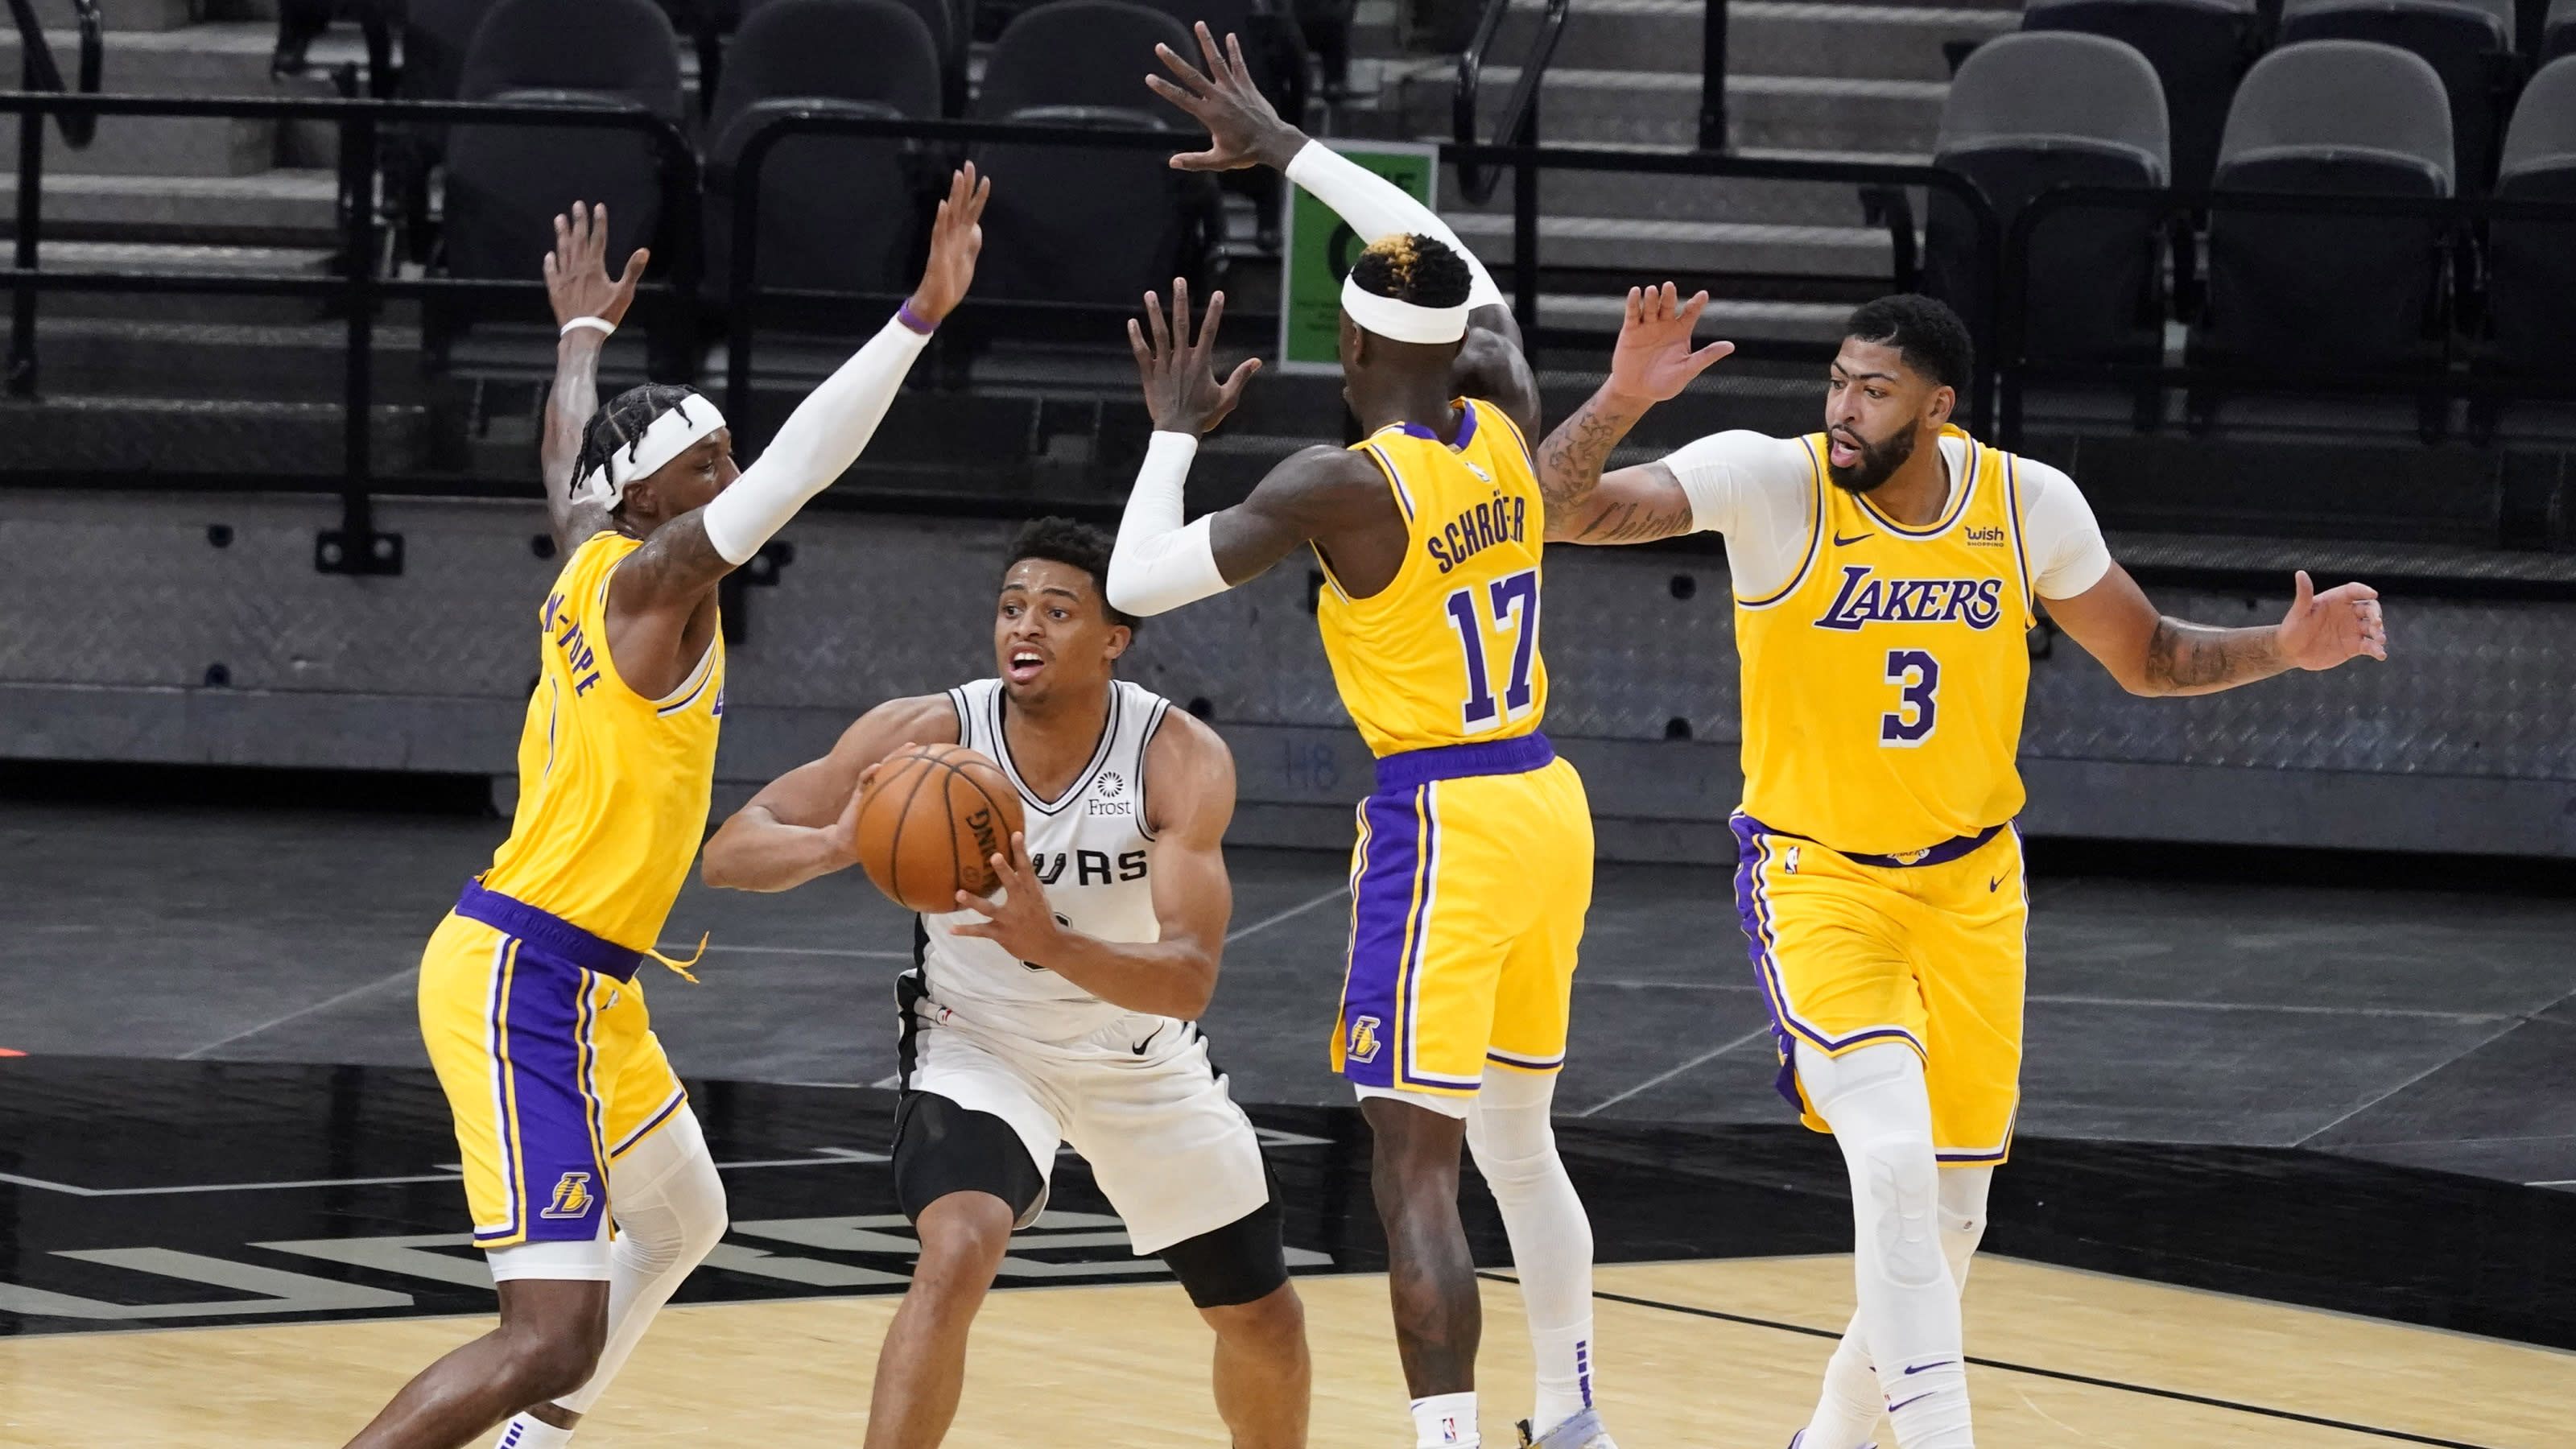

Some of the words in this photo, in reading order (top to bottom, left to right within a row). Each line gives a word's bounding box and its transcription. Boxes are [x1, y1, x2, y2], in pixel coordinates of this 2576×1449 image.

[1964, 526, 2004, 541] wish
[1811, 564, 2004, 632] LAKERS
[1444, 566, 1541, 736] 17
[1878, 648, 1942, 749] 3
[1088, 799, 1131, 815] Frost
[1032, 849, 1147, 886] URS
